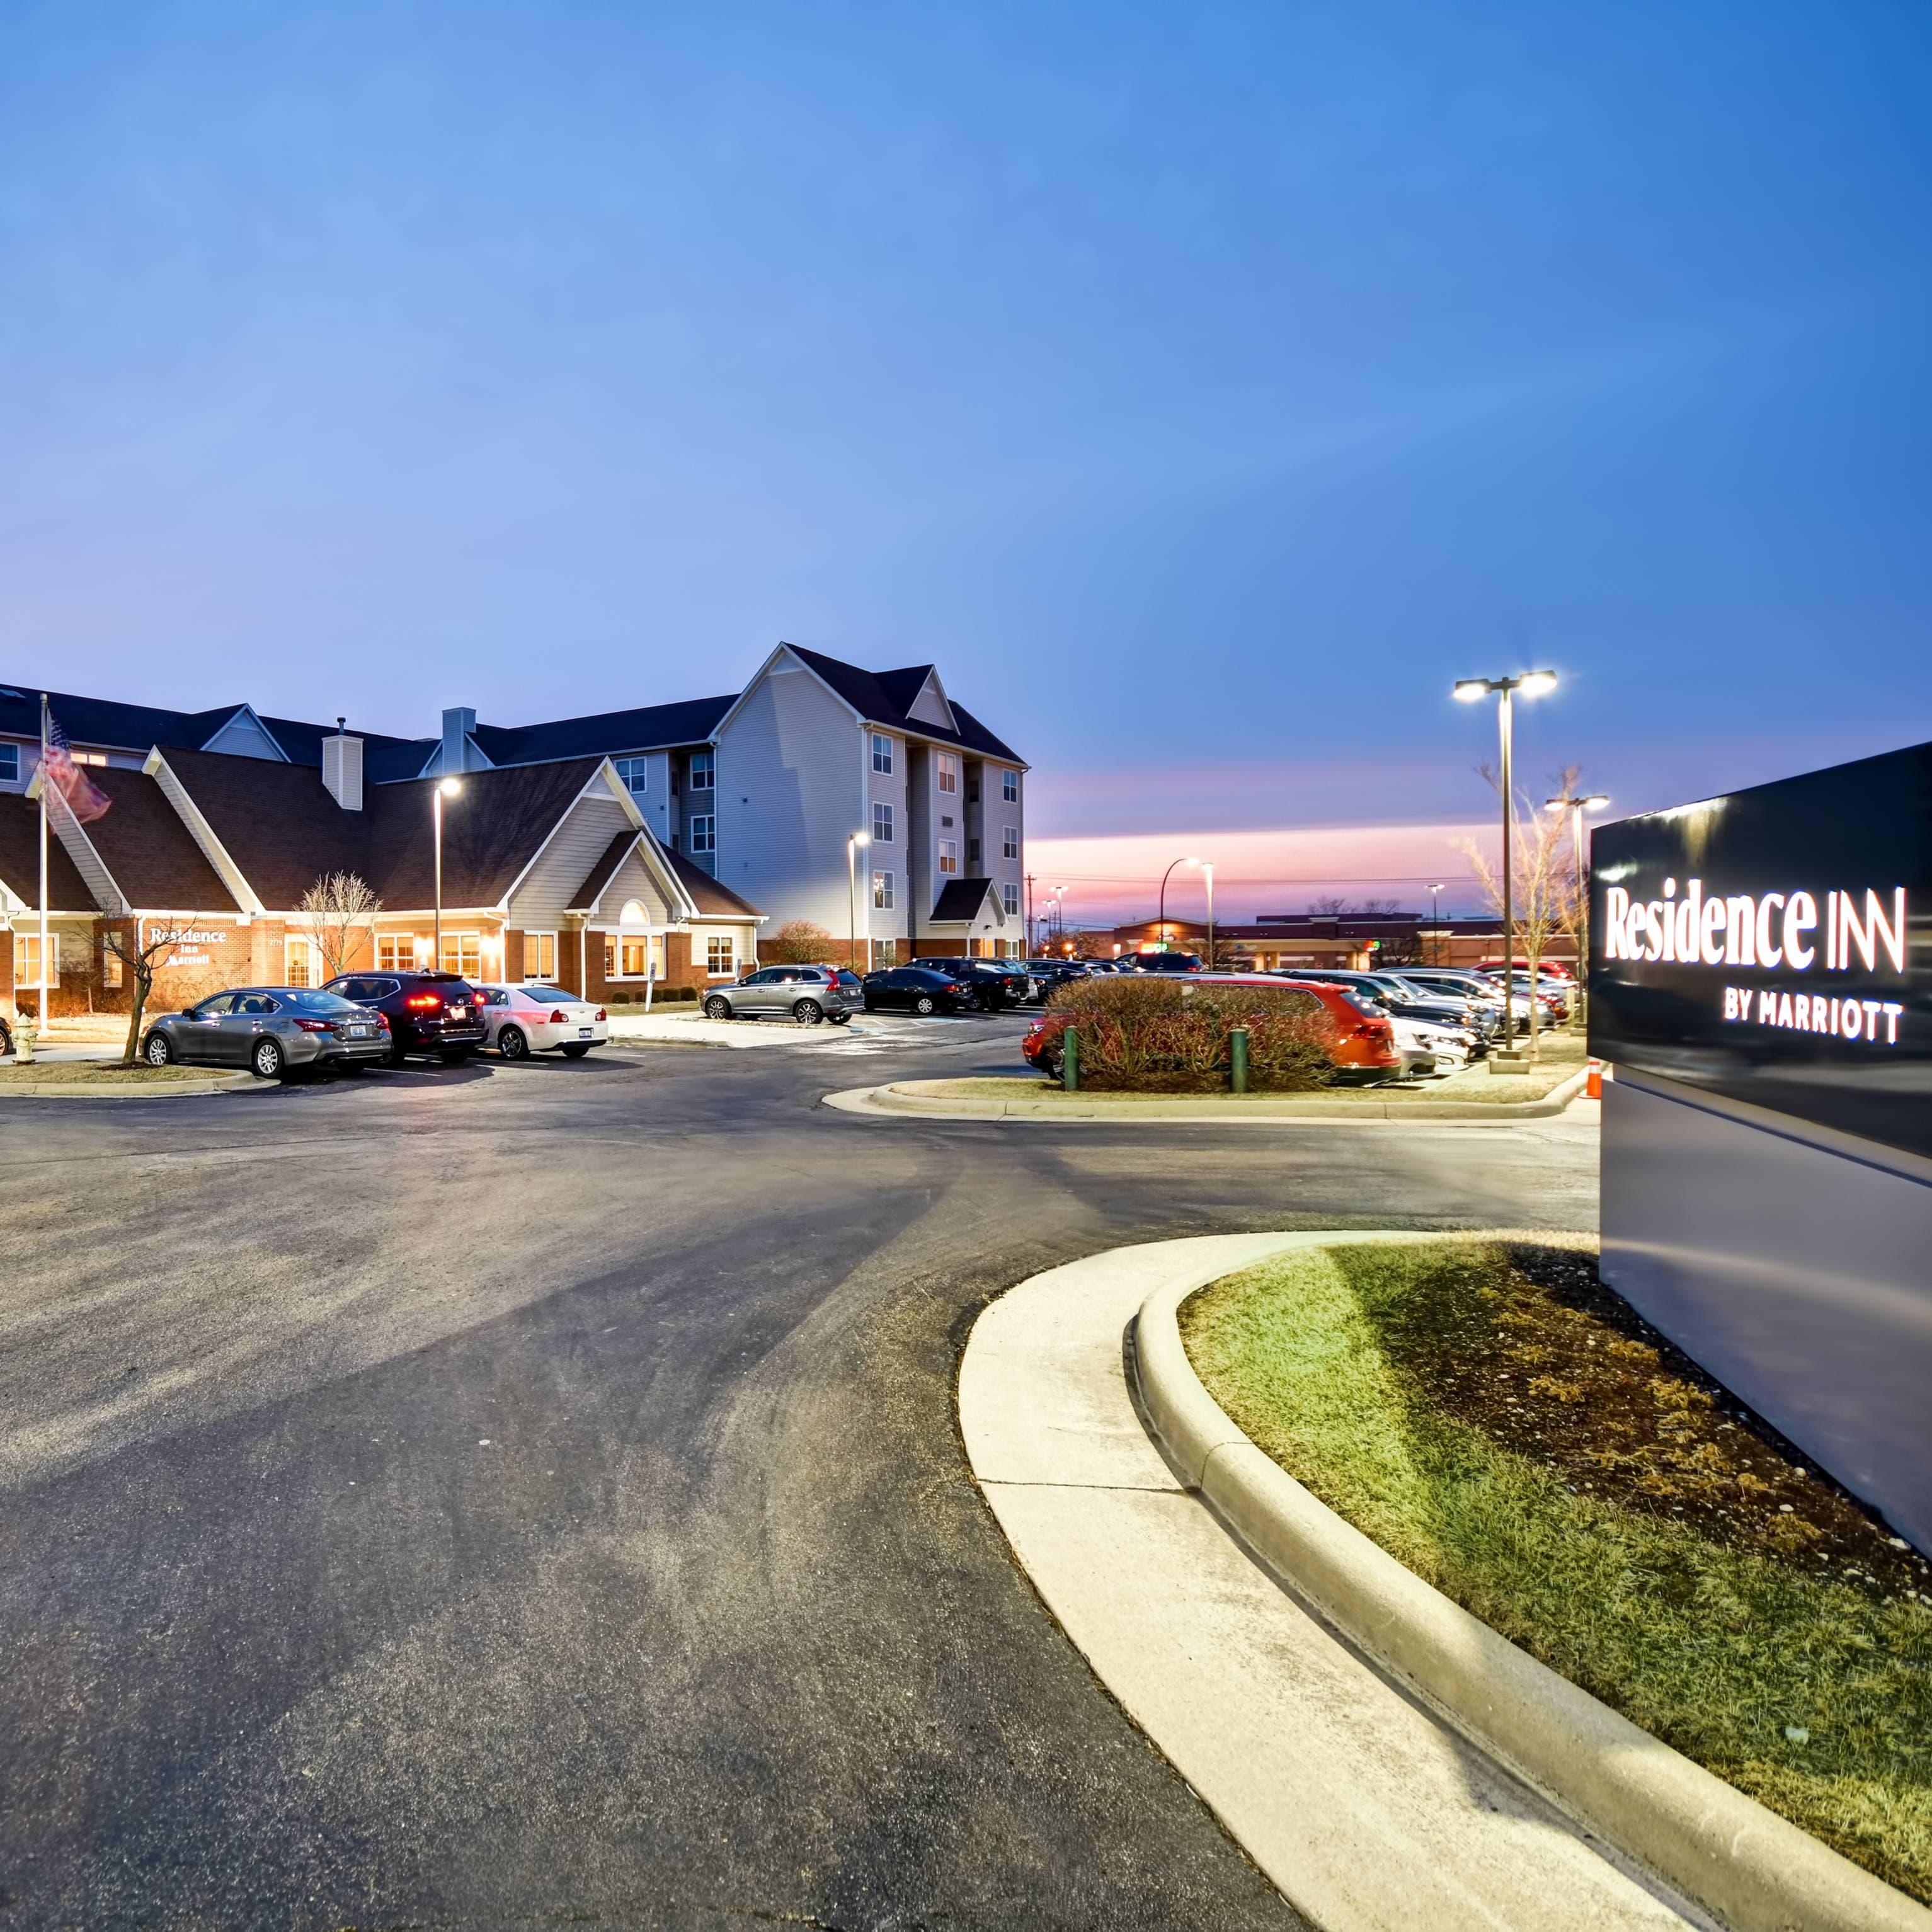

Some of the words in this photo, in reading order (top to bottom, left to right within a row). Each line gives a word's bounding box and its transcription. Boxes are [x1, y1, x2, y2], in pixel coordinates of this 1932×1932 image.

[150, 927, 227, 943] Residence
[1605, 877, 1818, 970] Residence
[1827, 886, 1906, 974] INN
[180, 944, 199, 953] Inn
[1723, 986, 1753, 1021] BY
[1759, 990, 1904, 1045] MARRIOTT
